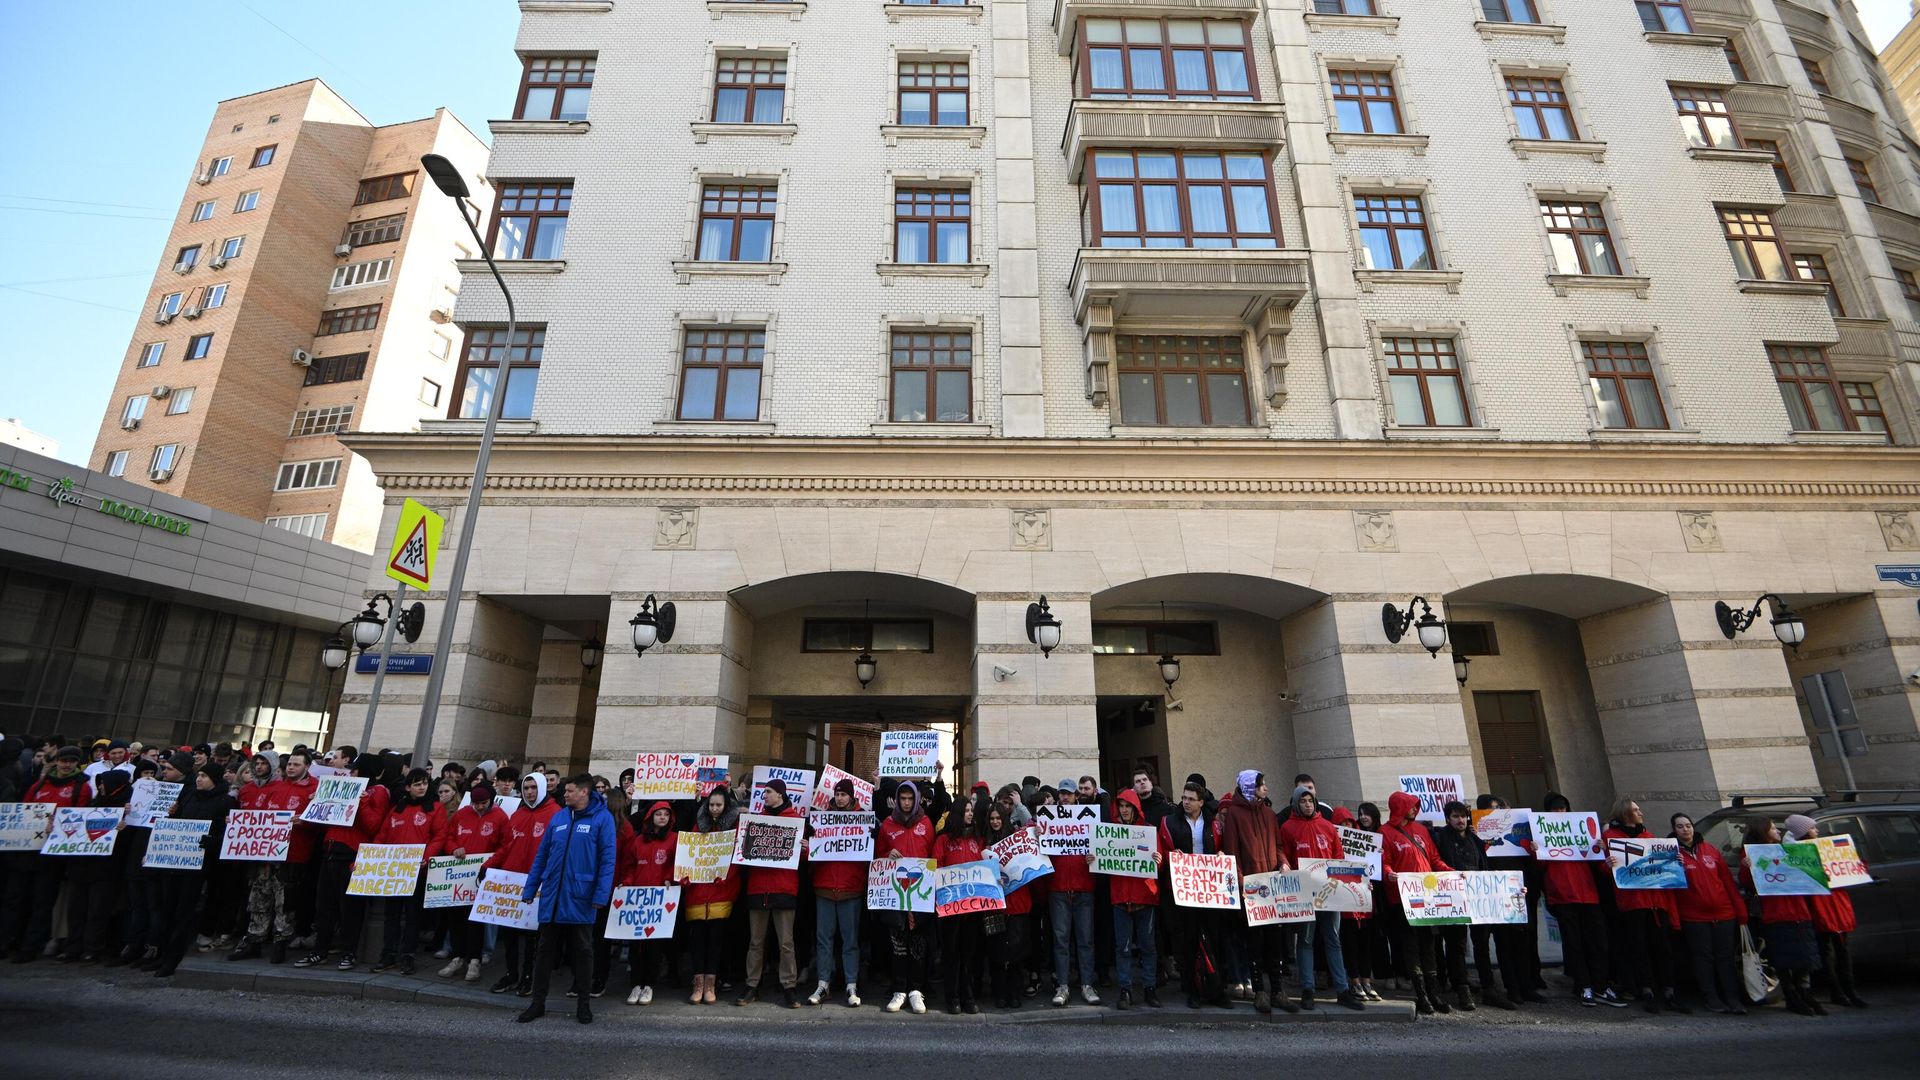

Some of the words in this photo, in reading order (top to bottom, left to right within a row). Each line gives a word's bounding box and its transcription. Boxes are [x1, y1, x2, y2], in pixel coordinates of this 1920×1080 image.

[100, 498, 192, 536] ПОДАРКИ
[371, 658, 415, 666] ПРОЧНЫЙ
[901, 741, 906, 749] С
[638, 754, 680, 767] КРЫМ
[636, 768, 645, 780] С
[768, 768, 803, 781] КРЫМ
[882, 766, 938, 774] СЕВАСТОПОЛЯ
[1401, 777, 1425, 793] УРОН
[232, 811, 275, 826] КРЫМ
[227, 827, 236, 839] С
[841, 826, 865, 837] СЕЯТЬ
[1039, 820, 1090, 837] УБИВАЕТ
[1096, 825, 1130, 839] КРЫМ
[47, 841, 110, 854] НАВСЕГДА
[227, 840, 279, 857] НАВЕК
[824, 836, 870, 853] СМЕРТЬ!
[1041, 838, 1090, 848] СТАРИКОВ
[1108, 840, 1115, 849] С
[871, 861, 897, 873] КРЫМ
[1098, 858, 1156, 873] НАВСЕГДА
[1171, 852, 1232, 871] БРИТАНИЯ
[941, 869, 982, 886] КРЫМ
[1174, 866, 1224, 884] ХВАТИТ
[346, 878, 415, 895] НАВСЕГДА
[1175, 878, 1217, 893] СЕЯТЬ
[1465, 874, 1507, 896] КРЫМ
[624, 887, 665, 906] КРЫМ
[874, 888, 893, 898] ЛЕТ
[1177, 889, 1230, 906] СМЕРТЬ
[1274, 896, 1297, 904] НЕ
[944, 902, 998, 916] РОССИЯ
[618, 907, 663, 926] РОССИЯ
